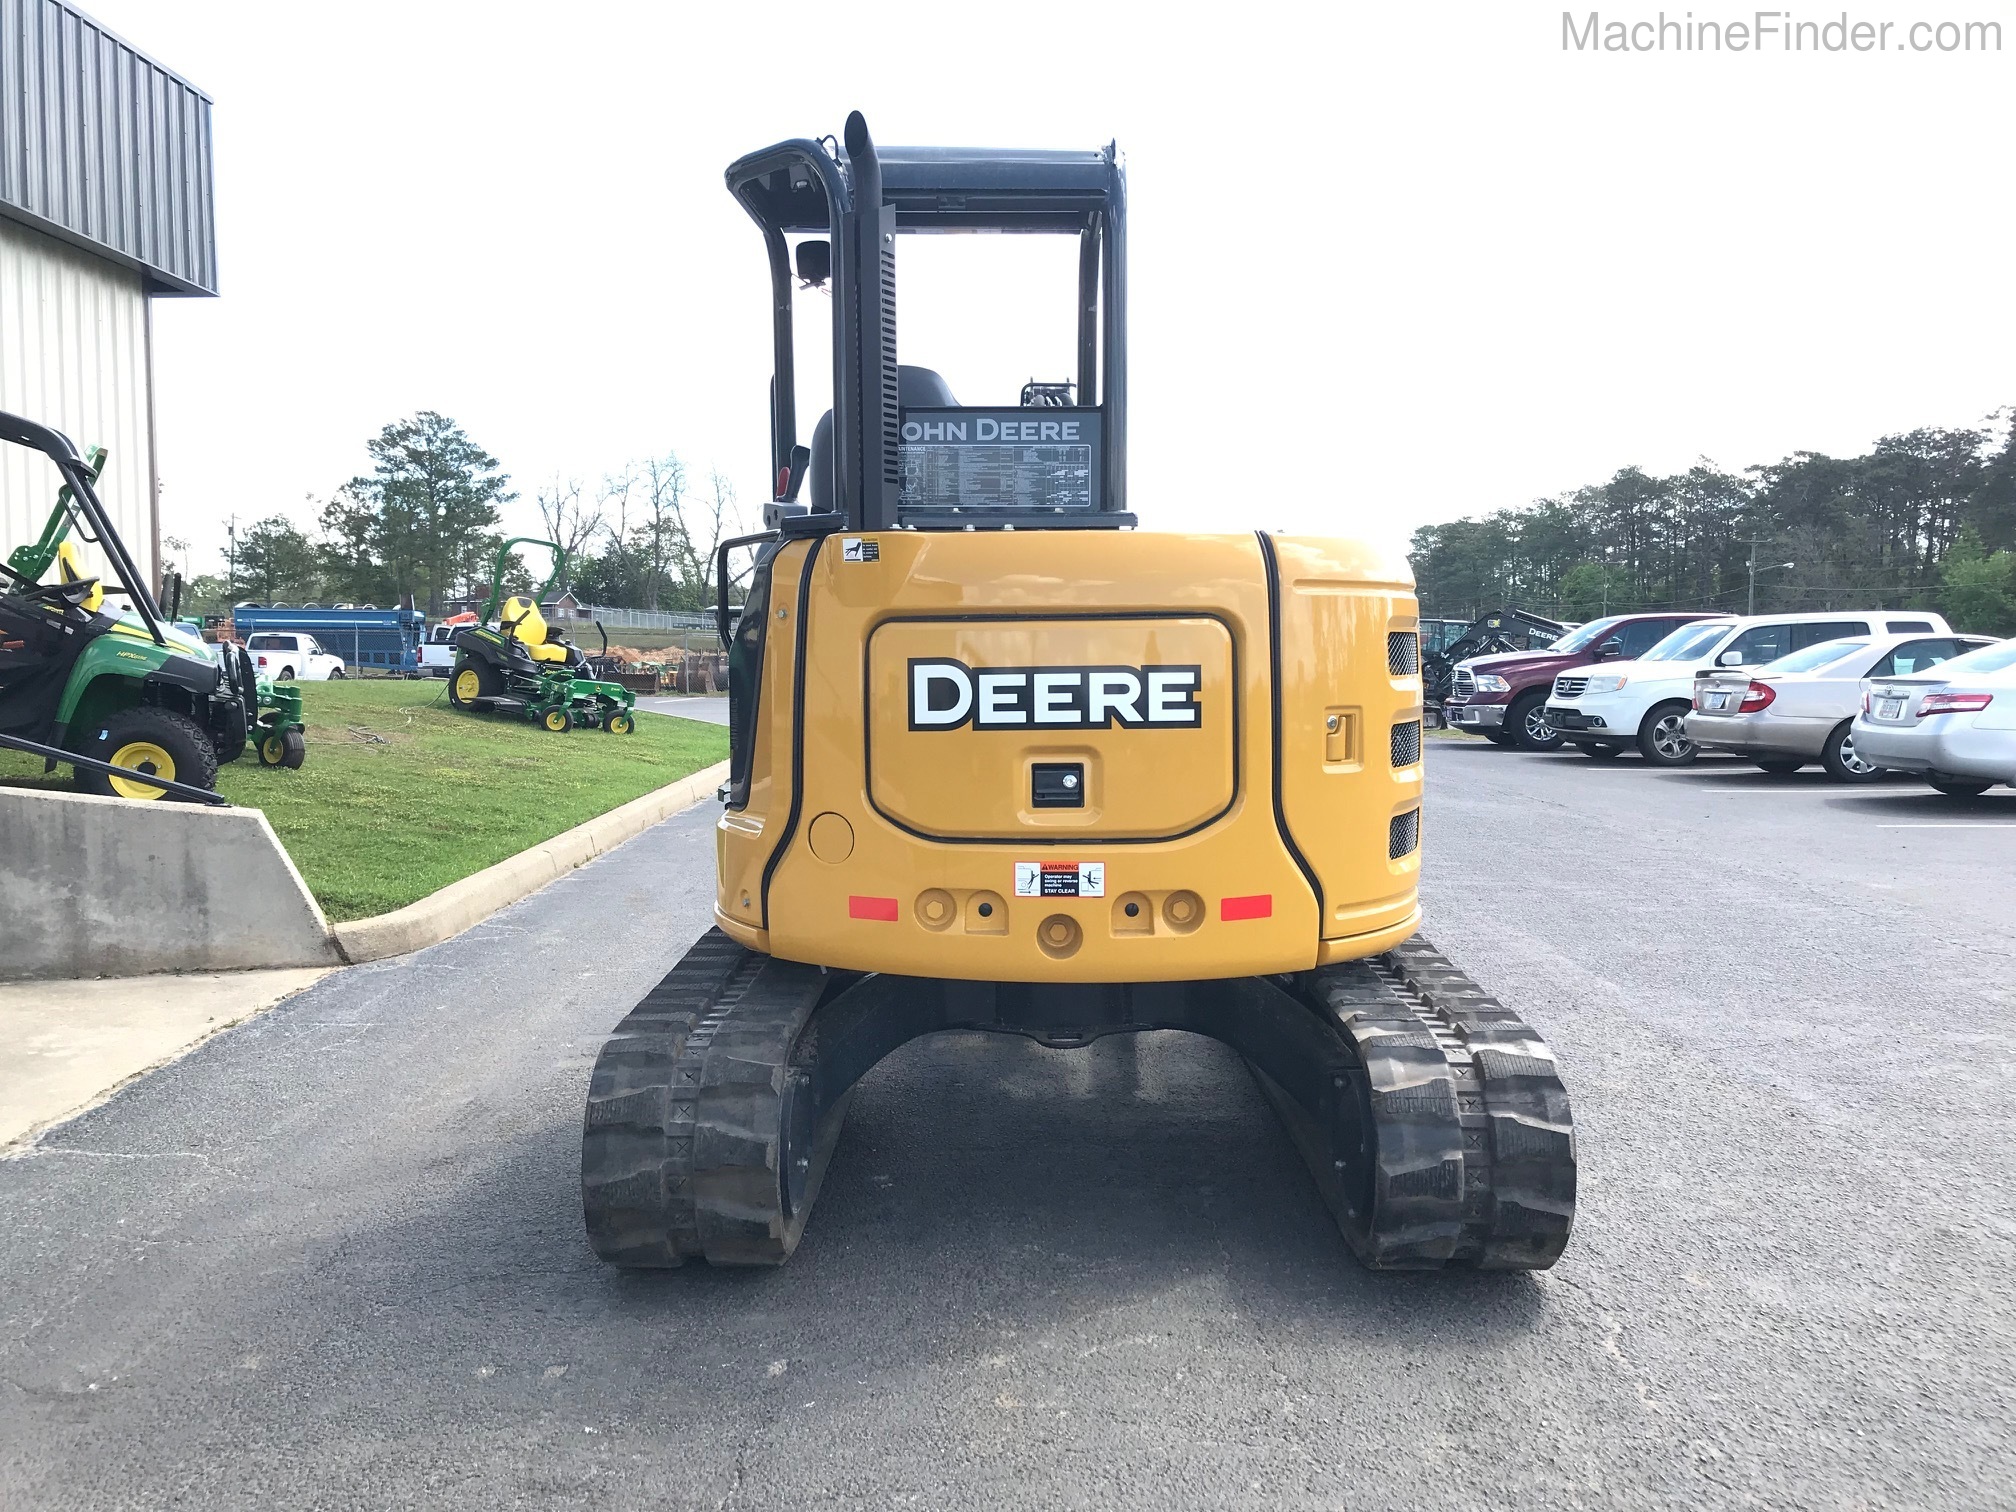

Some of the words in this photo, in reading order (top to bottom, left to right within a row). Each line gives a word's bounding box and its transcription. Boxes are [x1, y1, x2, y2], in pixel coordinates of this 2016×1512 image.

[901, 421, 967, 441] OHN
[976, 418, 1080, 441] DEERE
[1528, 628, 1559, 642] DEERE
[911, 663, 1197, 726] DEERE
